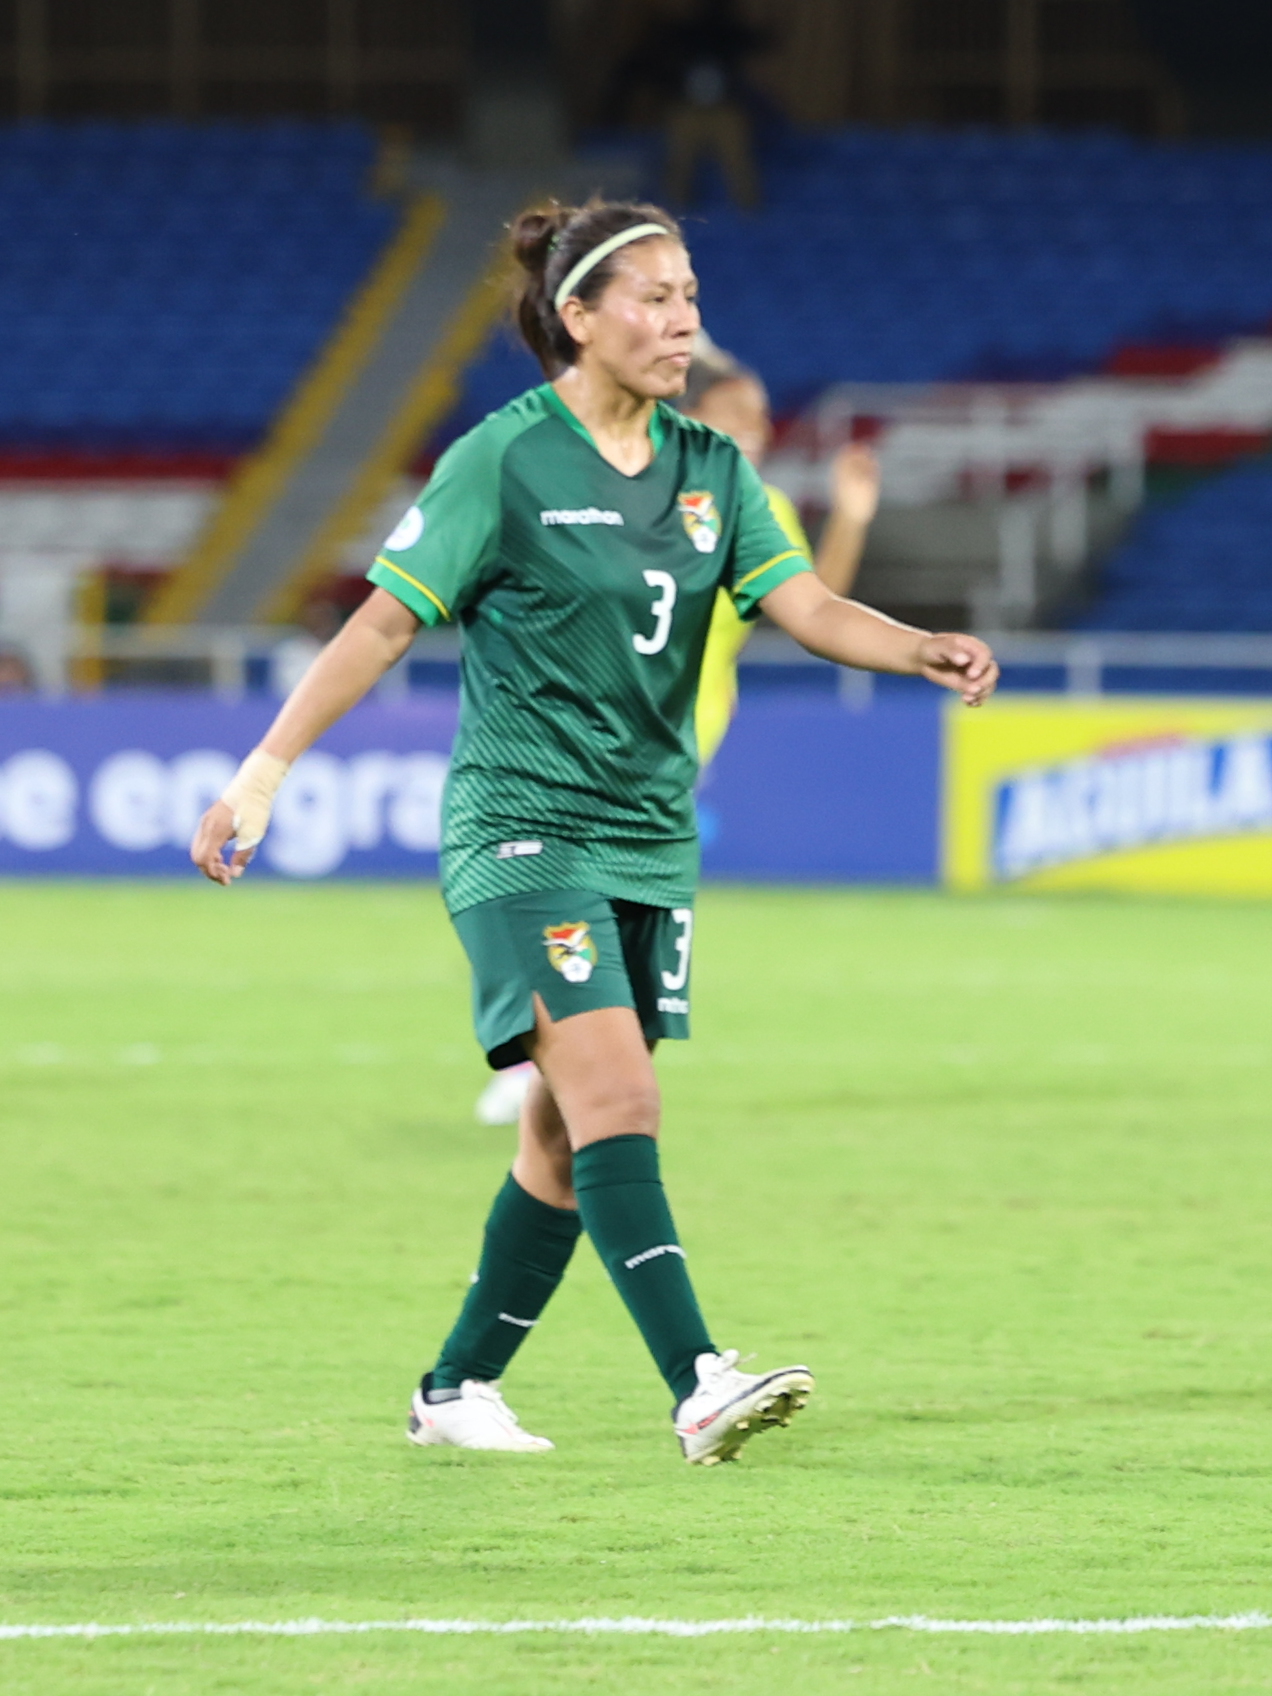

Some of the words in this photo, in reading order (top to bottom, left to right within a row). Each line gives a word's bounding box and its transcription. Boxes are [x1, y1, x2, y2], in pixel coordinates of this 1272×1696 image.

[632, 569, 677, 656] 3
[0, 748, 79, 853] e
[661, 907, 693, 991] 3
